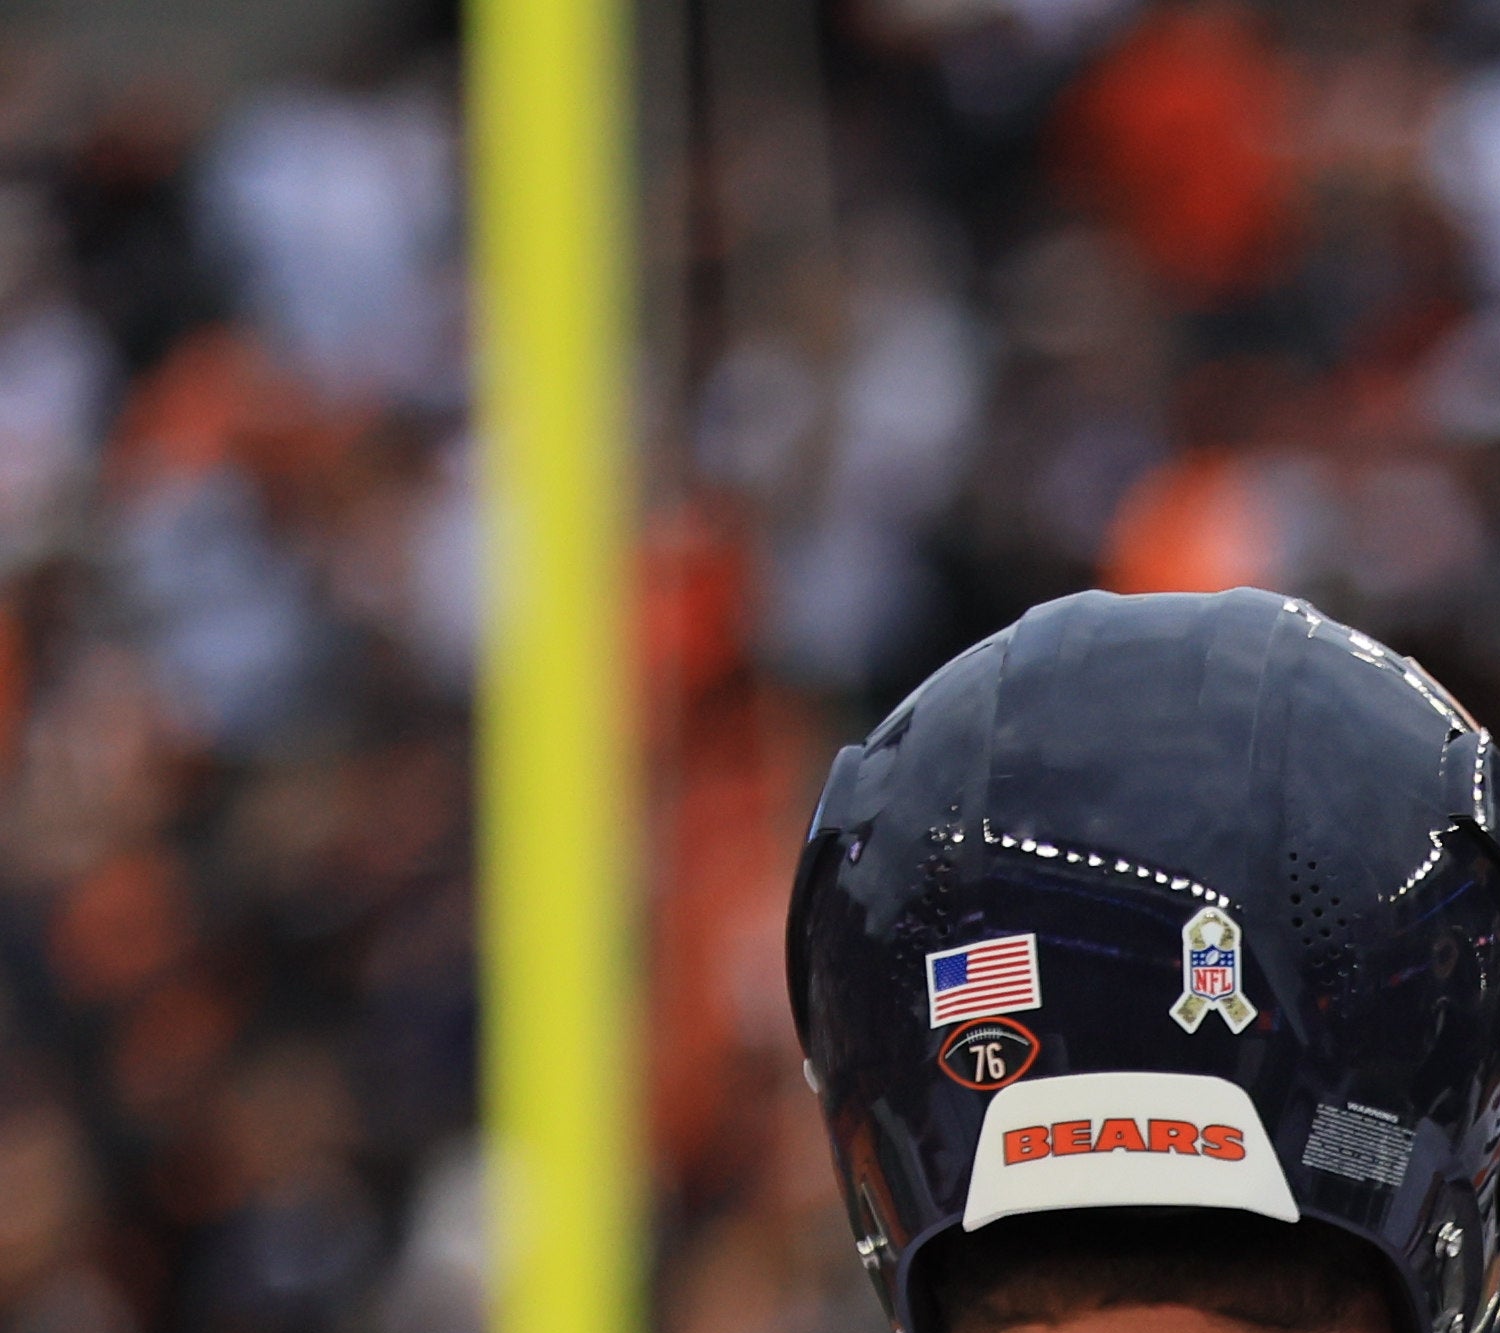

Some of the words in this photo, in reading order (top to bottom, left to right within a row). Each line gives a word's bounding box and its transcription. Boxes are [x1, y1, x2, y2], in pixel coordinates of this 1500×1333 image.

[1193, 968, 1232, 995] NFL
[968, 1042, 1006, 1083] 76
[1002, 1117, 1247, 1167] BEARS
